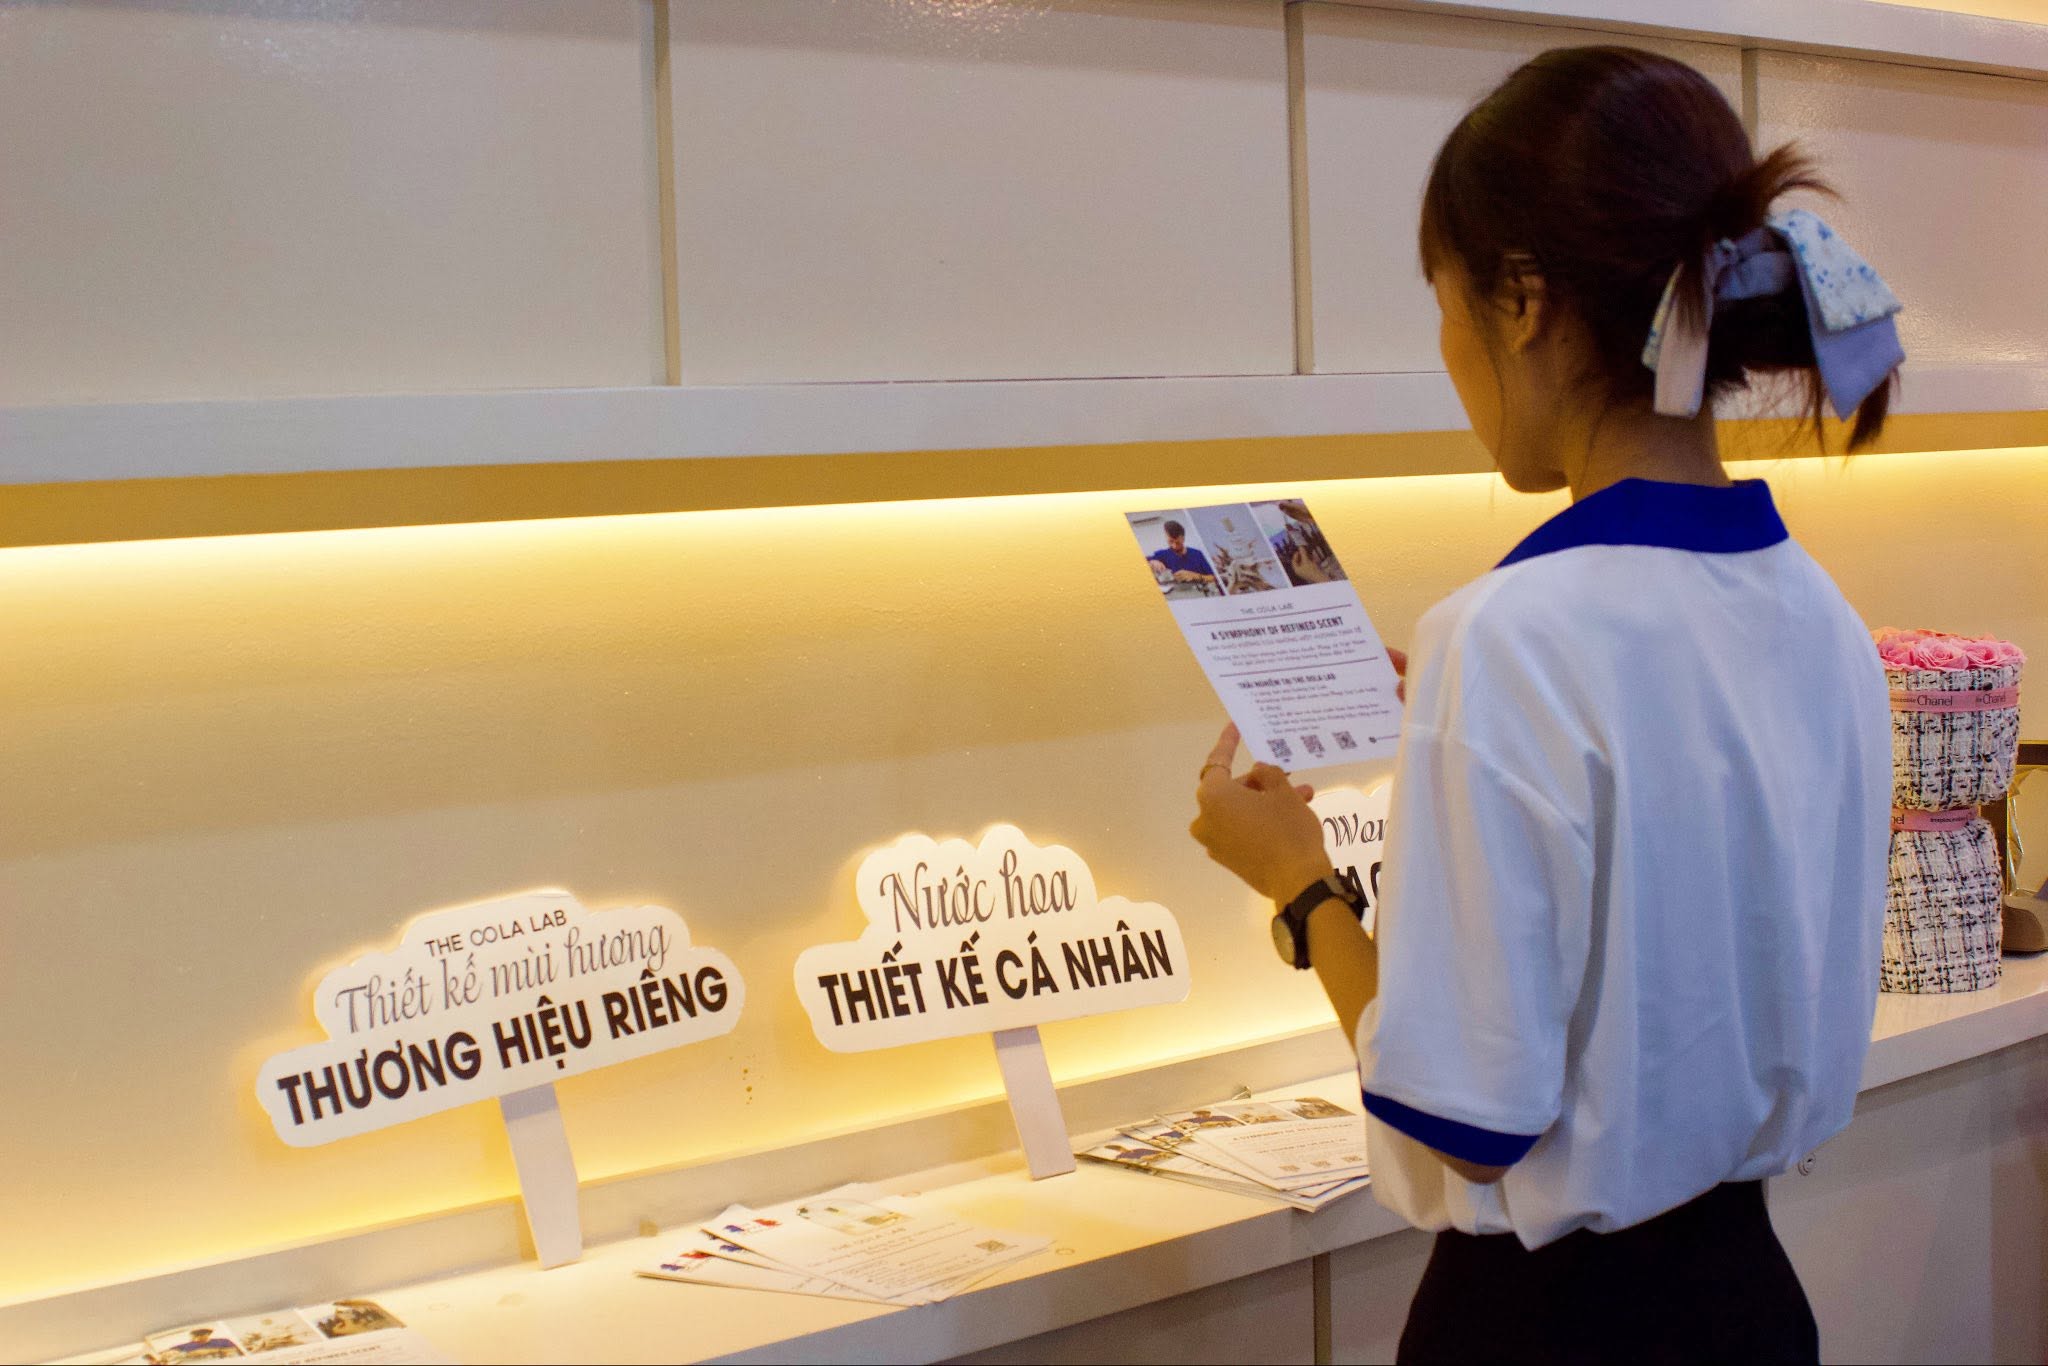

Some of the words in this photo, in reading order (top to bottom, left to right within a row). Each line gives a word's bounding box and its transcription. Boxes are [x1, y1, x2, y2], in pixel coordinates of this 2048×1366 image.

[1280, 620, 1317, 634] REFINED
[1317, 616, 1344, 629] SCENT
[1917, 695, 1952, 706] Chanel
[1982, 693, 2006, 705] Chanel
[879, 861, 996, 933] Nước
[999, 849, 1078, 919] hoa
[425, 933, 465, 958] THE
[529, 909, 567, 933] LAB
[818, 941, 927, 1026] THIẾT
[935, 930, 990, 1010] KẾ
[995, 931, 1060, 1000] CÁ
[1060, 920, 1174, 991] NHÂN
[334, 967, 431, 1034] Thiết
[442, 951, 484, 1010] kế
[489, 944, 559, 998] mùi
[566, 925, 672, 977] hương
[277, 1030, 482, 1125] THƯƠNG
[492, 996, 593, 1071] HIỆU
[602, 965, 729, 1040] RIÊNG
